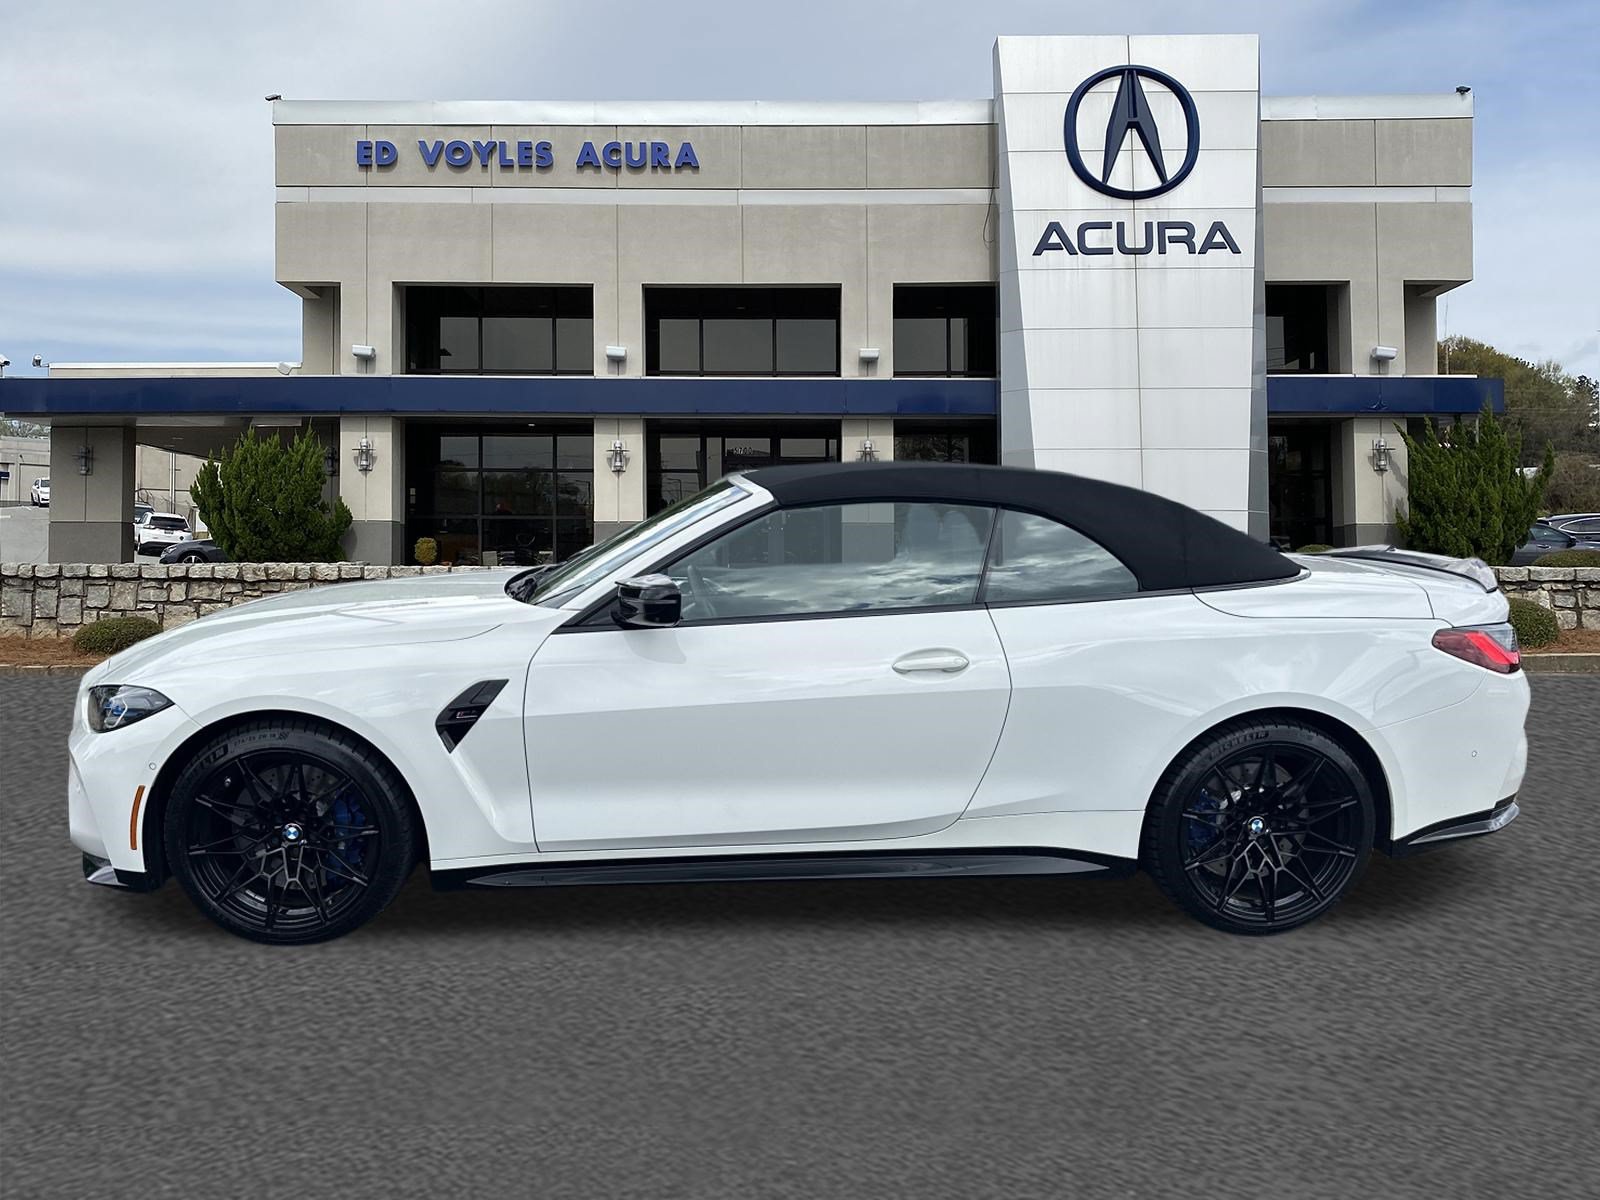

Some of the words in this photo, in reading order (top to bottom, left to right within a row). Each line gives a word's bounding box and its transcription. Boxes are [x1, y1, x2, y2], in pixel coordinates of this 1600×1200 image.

[356, 140, 398, 168] ED
[418, 140, 554, 168] VOYLES
[576, 141, 700, 169] ACURA
[1032, 221, 1242, 256] ACURA
